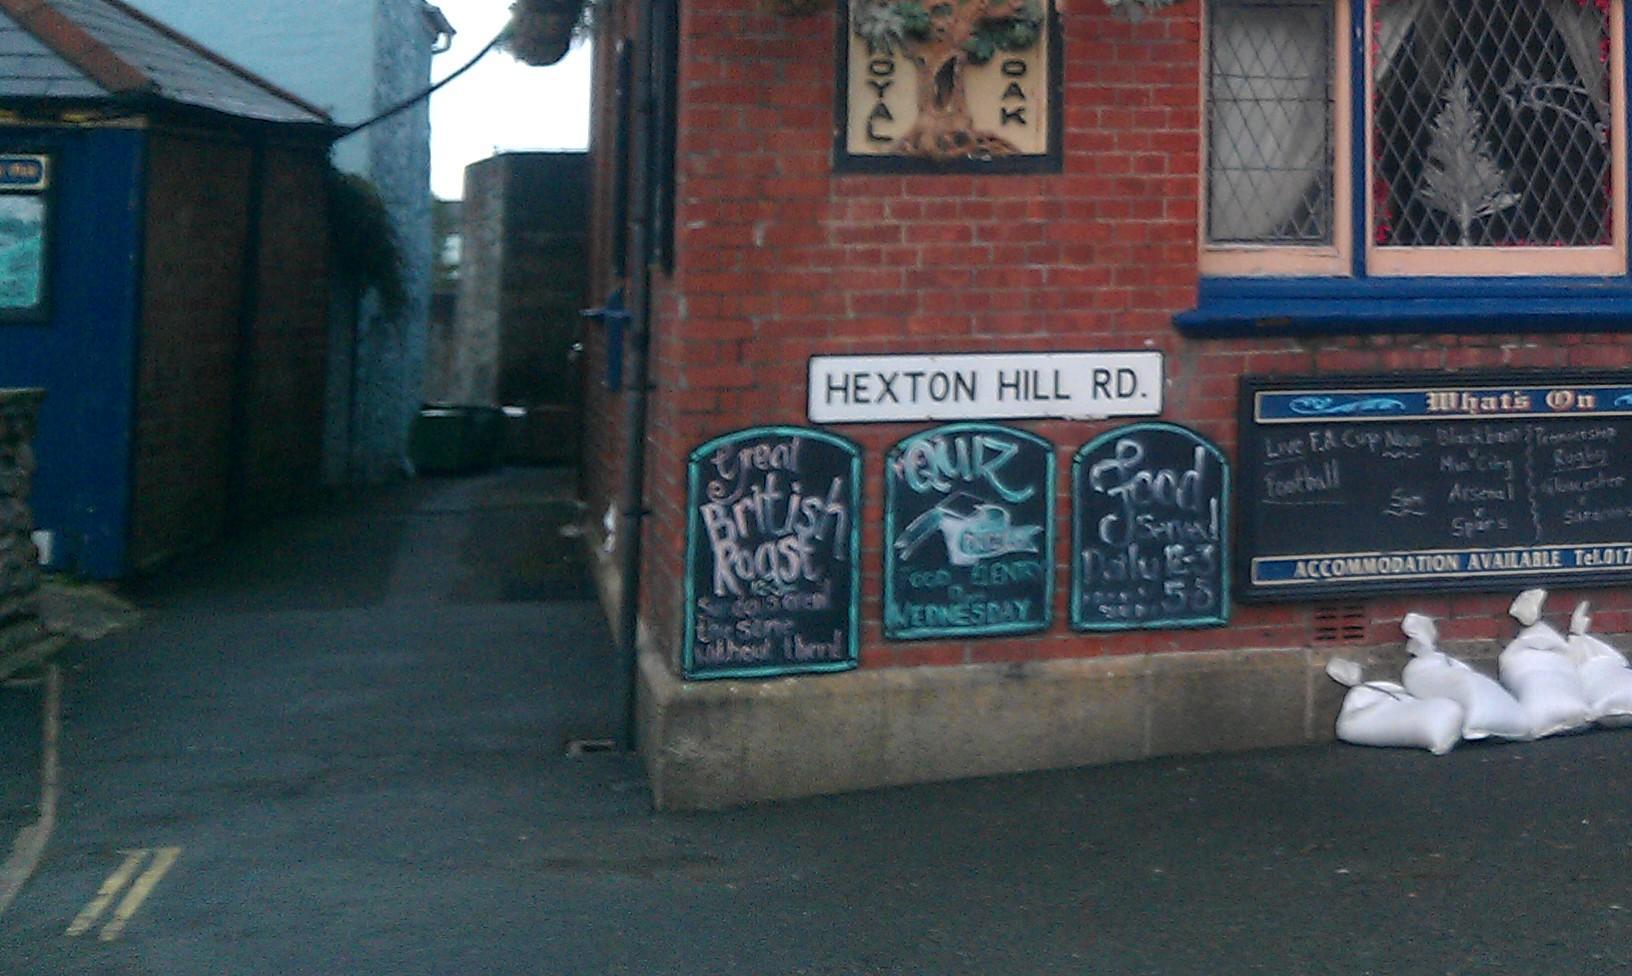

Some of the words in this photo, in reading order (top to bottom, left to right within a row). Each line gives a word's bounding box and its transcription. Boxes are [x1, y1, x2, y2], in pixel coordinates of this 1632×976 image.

[1001, 60, 1027, 125] OAK
[825, 371, 976, 404] HEXTON
[997, 369, 1072, 402] HILL
[1091, 368, 1148, 401] RD.
[1426, 390, 1531, 415] What's
[1545, 390, 1597, 411] On
[1341, 428, 1382, 452] Cup
[700, 472, 847, 561] British
[713, 533, 822, 597] Roast
[1294, 555, 1459, 578] ACCOMMODATION
[1466, 550, 1562, 571] AVAILABLE
